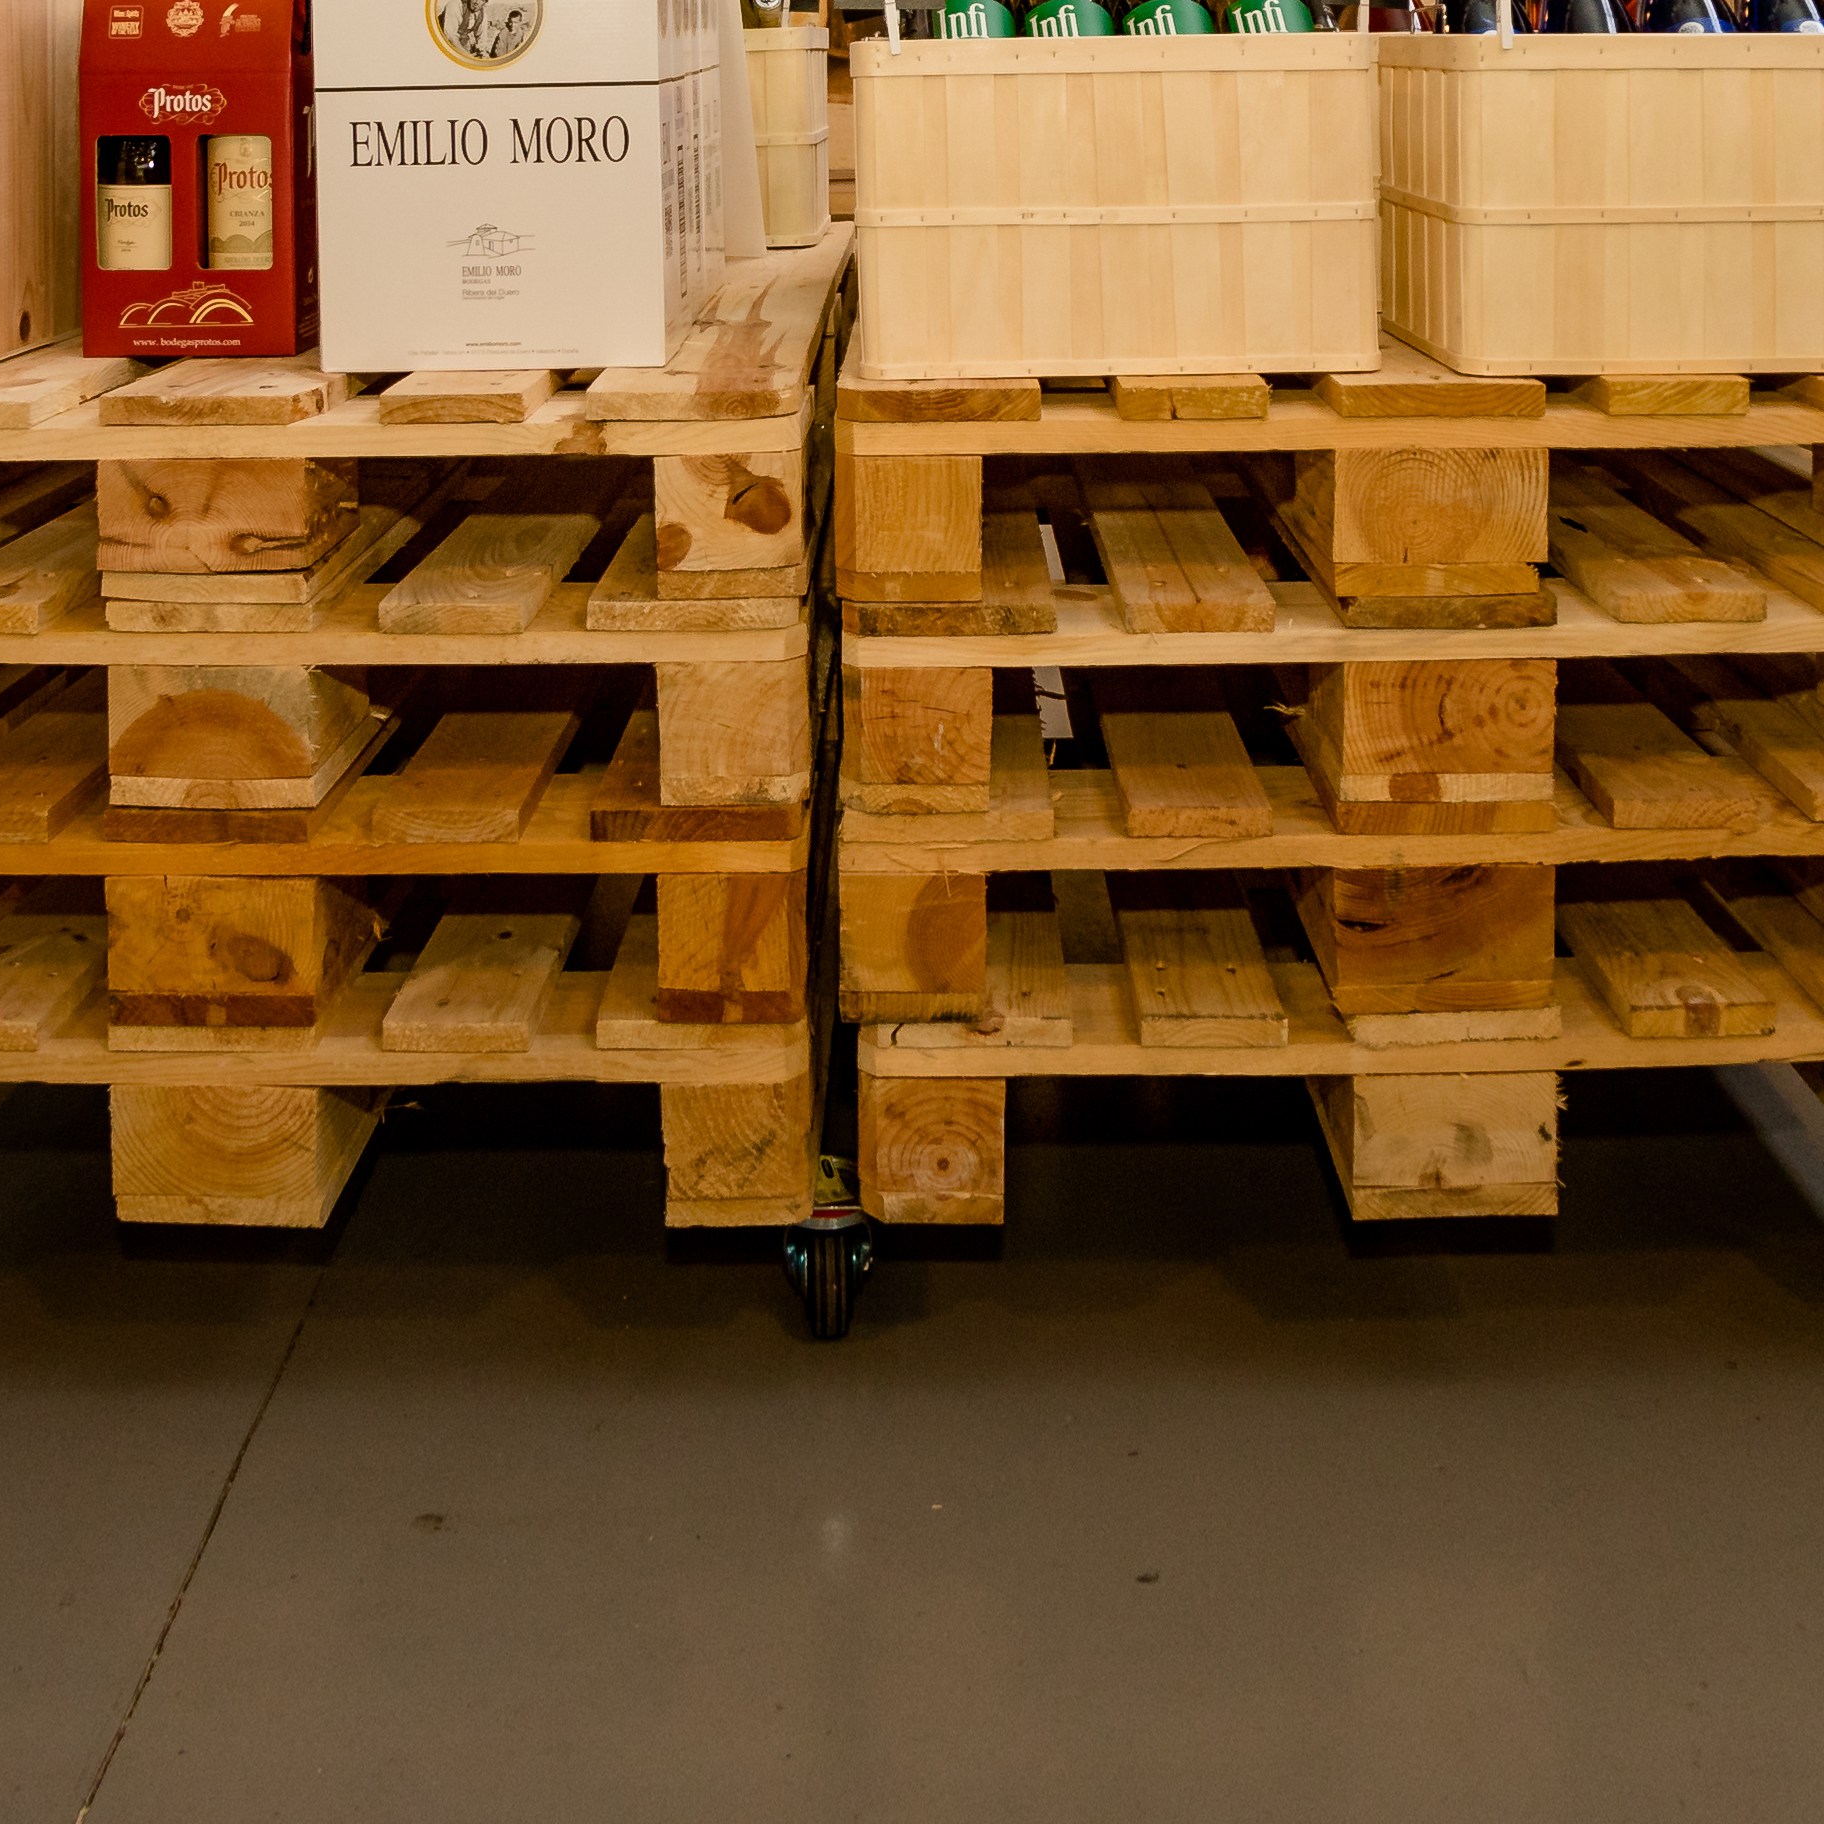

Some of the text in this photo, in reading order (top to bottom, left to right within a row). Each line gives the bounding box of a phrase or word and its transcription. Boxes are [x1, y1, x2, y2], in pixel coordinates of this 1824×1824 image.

[147, 87, 212, 119] Protos
[349, 114, 631, 167] EMILIO MORO
[104, 197, 149, 222] Protos
[229, 210, 265, 219] CRIANZA
[462, 264, 522, 278] EMILIO MORO
[462, 288, 520, 297] Ribera del Duero
[133, 337, 242, 349] www. bodegasprotos.com
